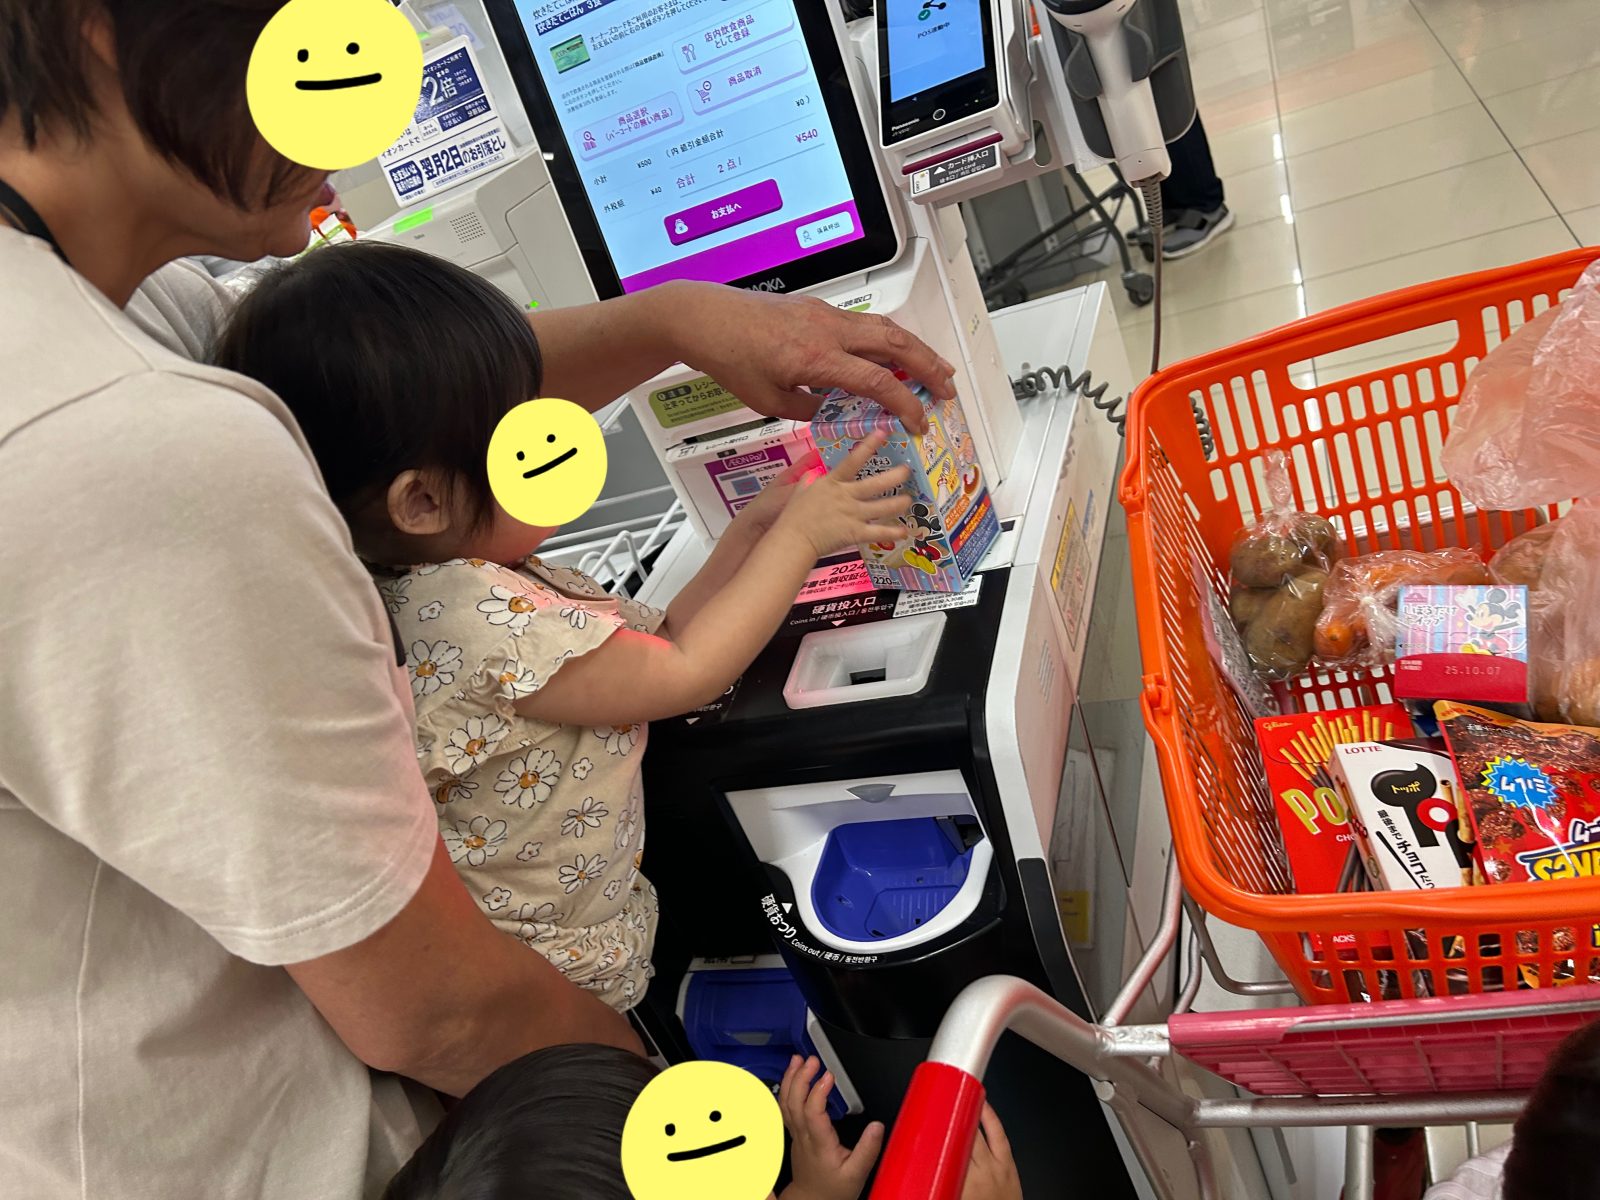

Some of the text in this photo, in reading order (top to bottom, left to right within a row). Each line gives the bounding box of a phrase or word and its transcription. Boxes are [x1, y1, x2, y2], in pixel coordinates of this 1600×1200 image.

[537, 4, 584, 33] 炊きたてごはん
[704, 14, 755, 43] 店内飲食商品
[715, 28, 751, 49] として登録
[727, 65, 762, 87] 商品取消
[618, 106, 650, 127] 商品選択
[419, 134, 507, 181] 翌月2日のお引落とし
[675, 173, 696, 190] 合計
[795, 128, 819, 144] ¥540
[946, 149, 990, 171] カード挿入口
[593, 158, 652, 186] 小計 ¥500
[710, 202, 743, 221] お支払へ
[811, 596, 877, 615] 硬貨投入口
[1443, 665, 1501, 676] 25.10.07
[1344, 745, 1382, 755] LOTTE
[1391, 780, 1421, 795] トッポ
[1500, 776, 1546, 795] ミルク
[760, 893, 798, 940] 硬貨おつり
[791, 937, 809, 954] Coins
[808, 947, 820, 958] out
